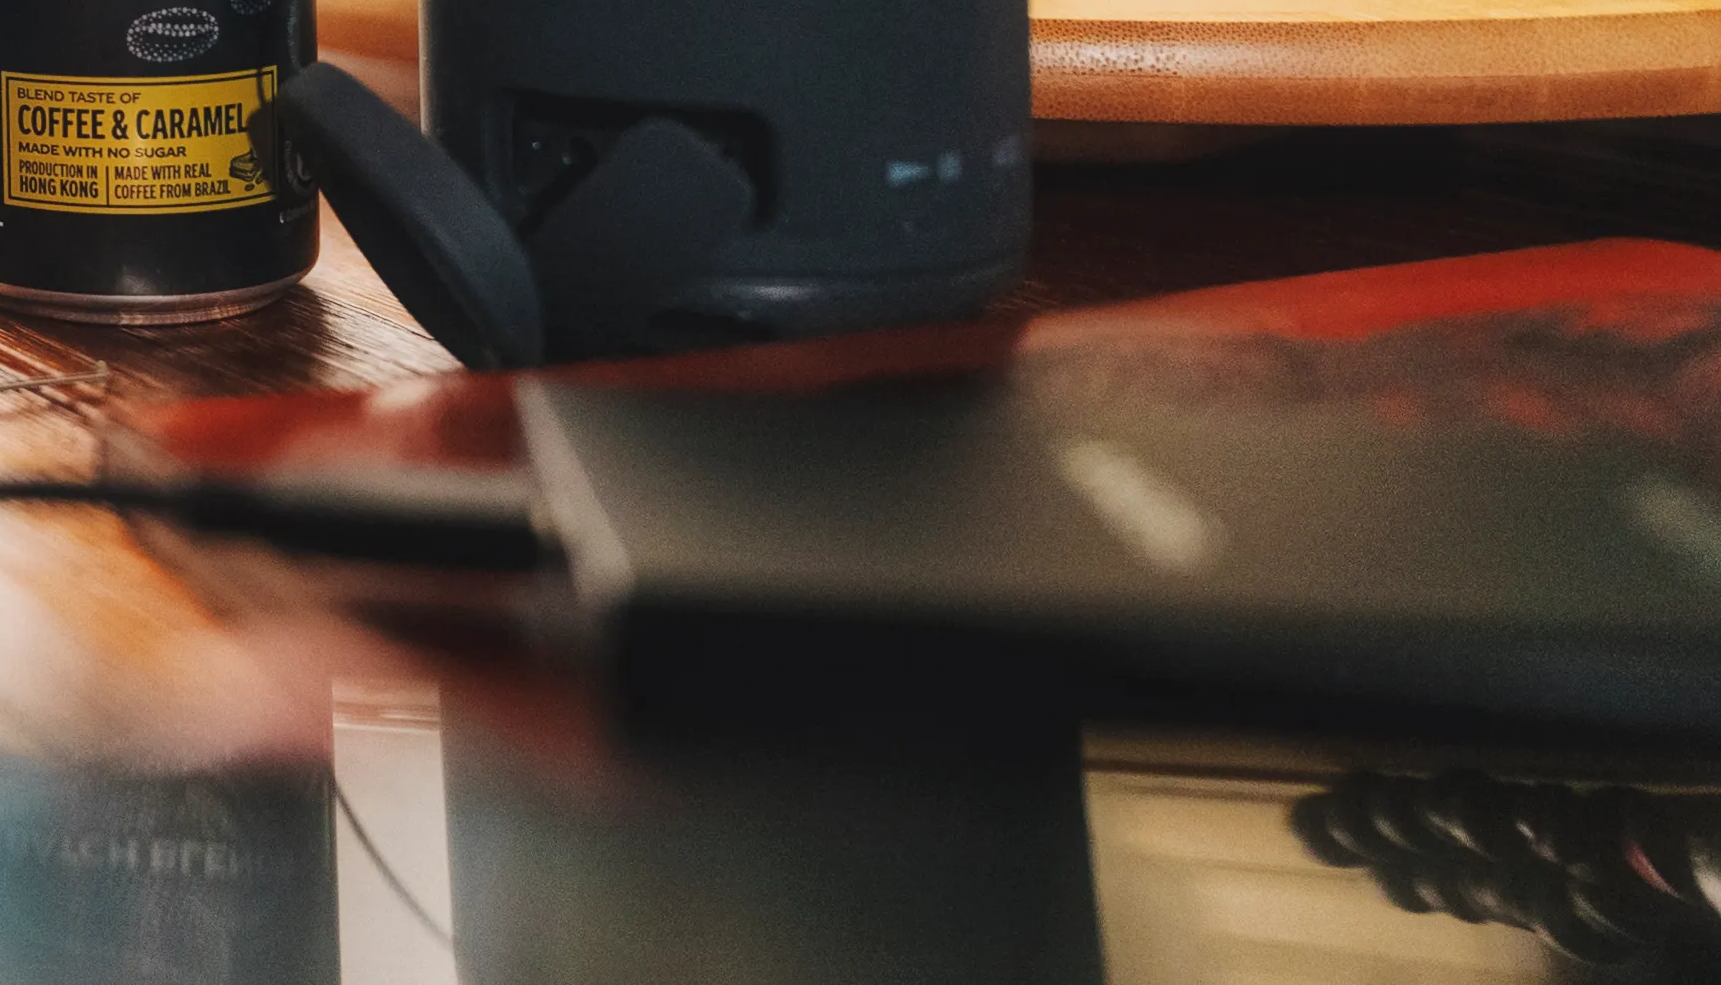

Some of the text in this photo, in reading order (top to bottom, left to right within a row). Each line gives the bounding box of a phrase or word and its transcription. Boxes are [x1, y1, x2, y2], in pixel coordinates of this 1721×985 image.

[17, 87, 142, 104] BLEND TASTE OF
[17, 102, 249, 140] COFFEE & CARAMEL
[18, 141, 187, 159] MADE WITH NO SUGAR
[18, 160, 98, 179] PRODUCTION IN
[114, 162, 212, 181] MADE WITH REAL
[19, 176, 99, 199] HONG KONG
[114, 179, 232, 200] COFFEE FROM BRAZIL
